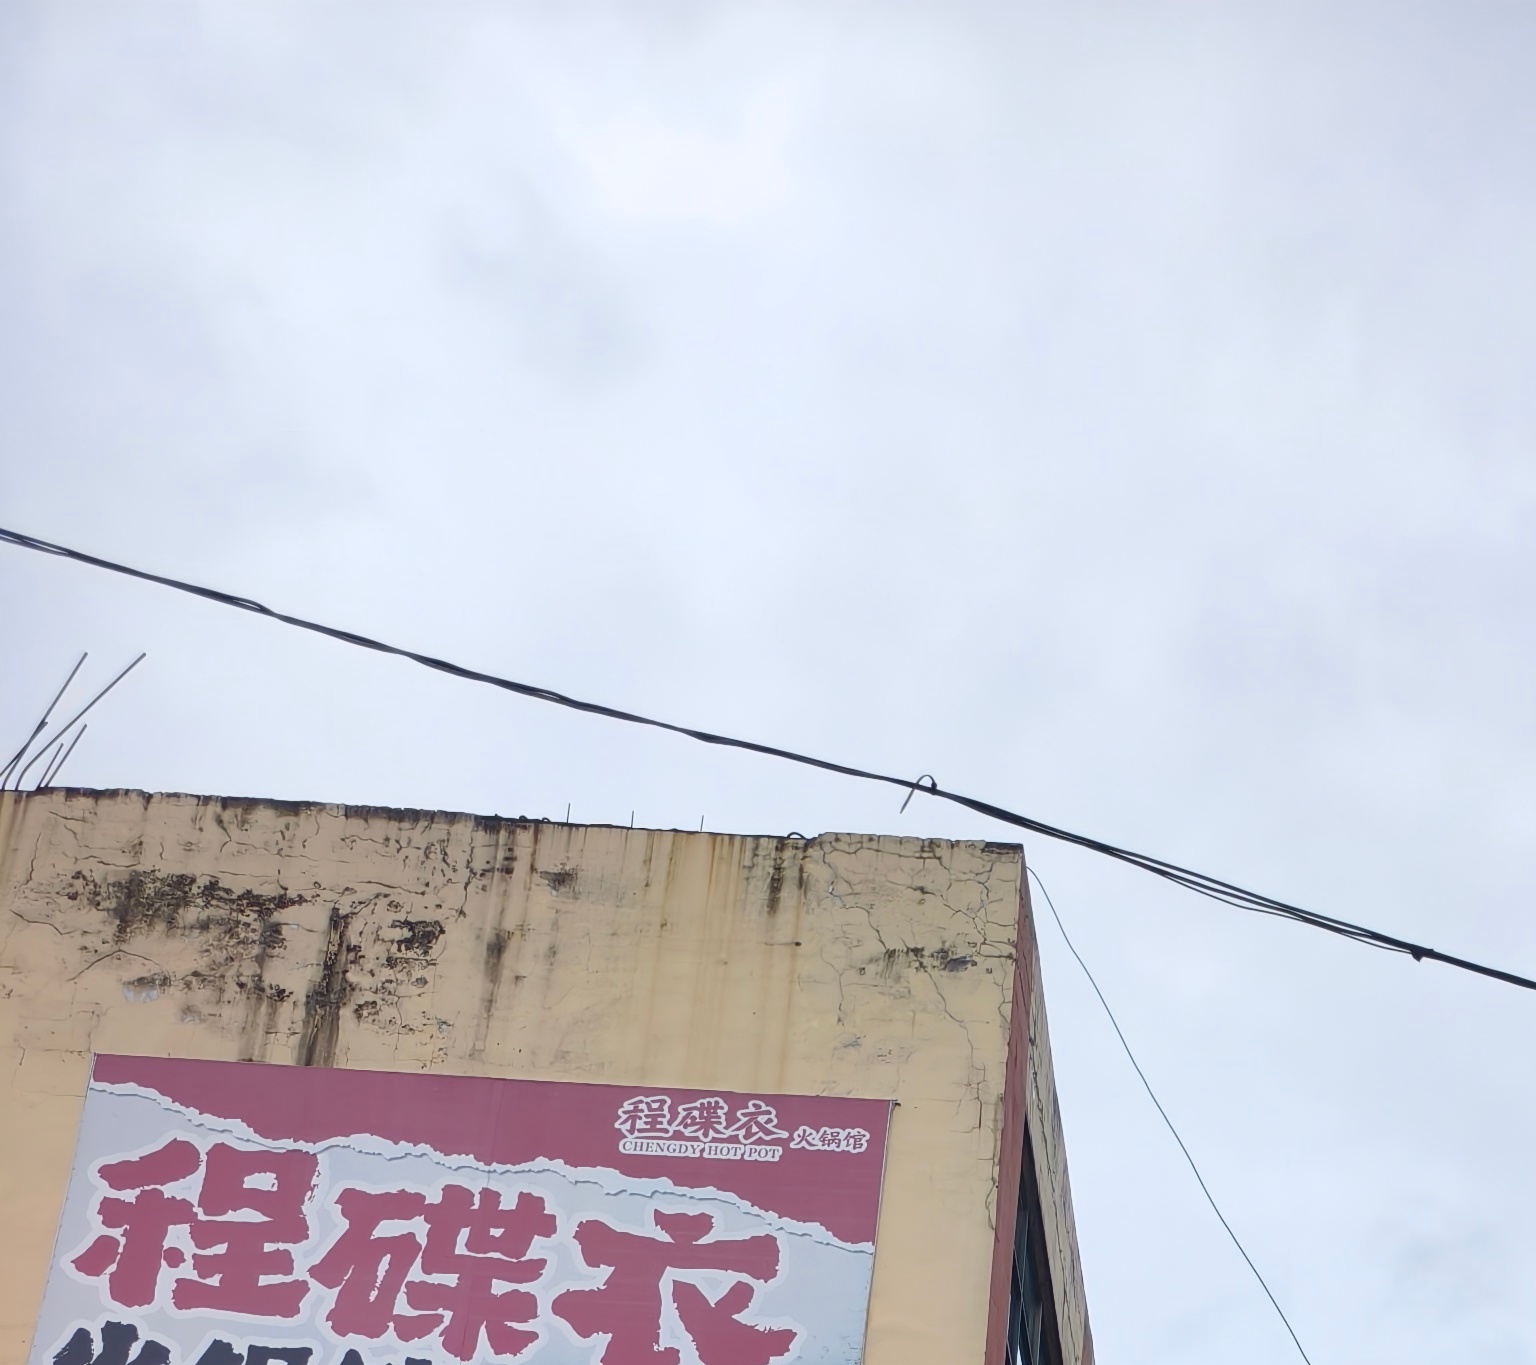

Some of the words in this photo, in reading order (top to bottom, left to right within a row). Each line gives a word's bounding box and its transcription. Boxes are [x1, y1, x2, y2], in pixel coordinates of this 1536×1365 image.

[615, 1097, 789, 1142] 程碟衣
[622, 1140, 700, 1157] CHENGDY
[706, 1145, 742, 1158] HOT
[748, 1147, 780, 1160] POT
[791, 1127, 867, 1151] 火锅馆
